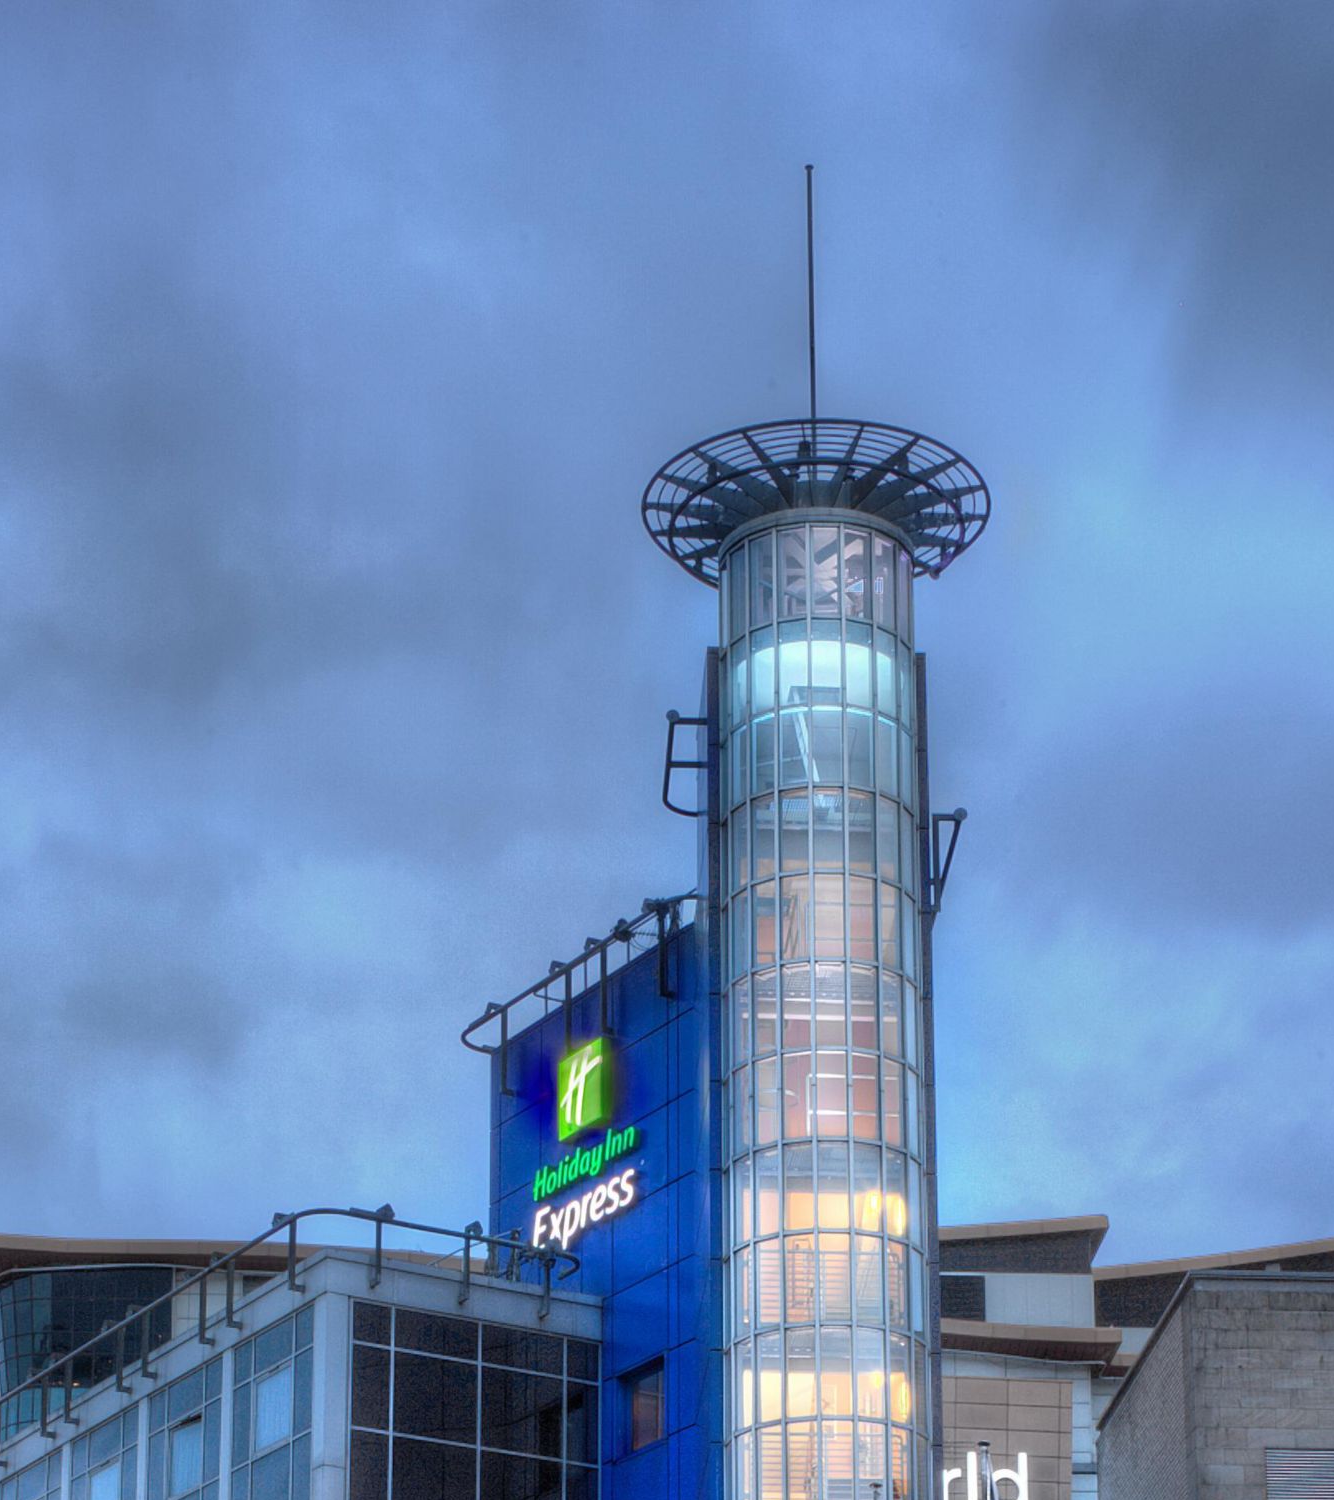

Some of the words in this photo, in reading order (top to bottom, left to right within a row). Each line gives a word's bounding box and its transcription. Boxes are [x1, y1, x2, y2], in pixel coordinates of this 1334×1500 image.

[533, 1144, 604, 1201] Holiday
[605, 1126, 635, 1161] Inn
[533, 1168, 635, 1250] Express
